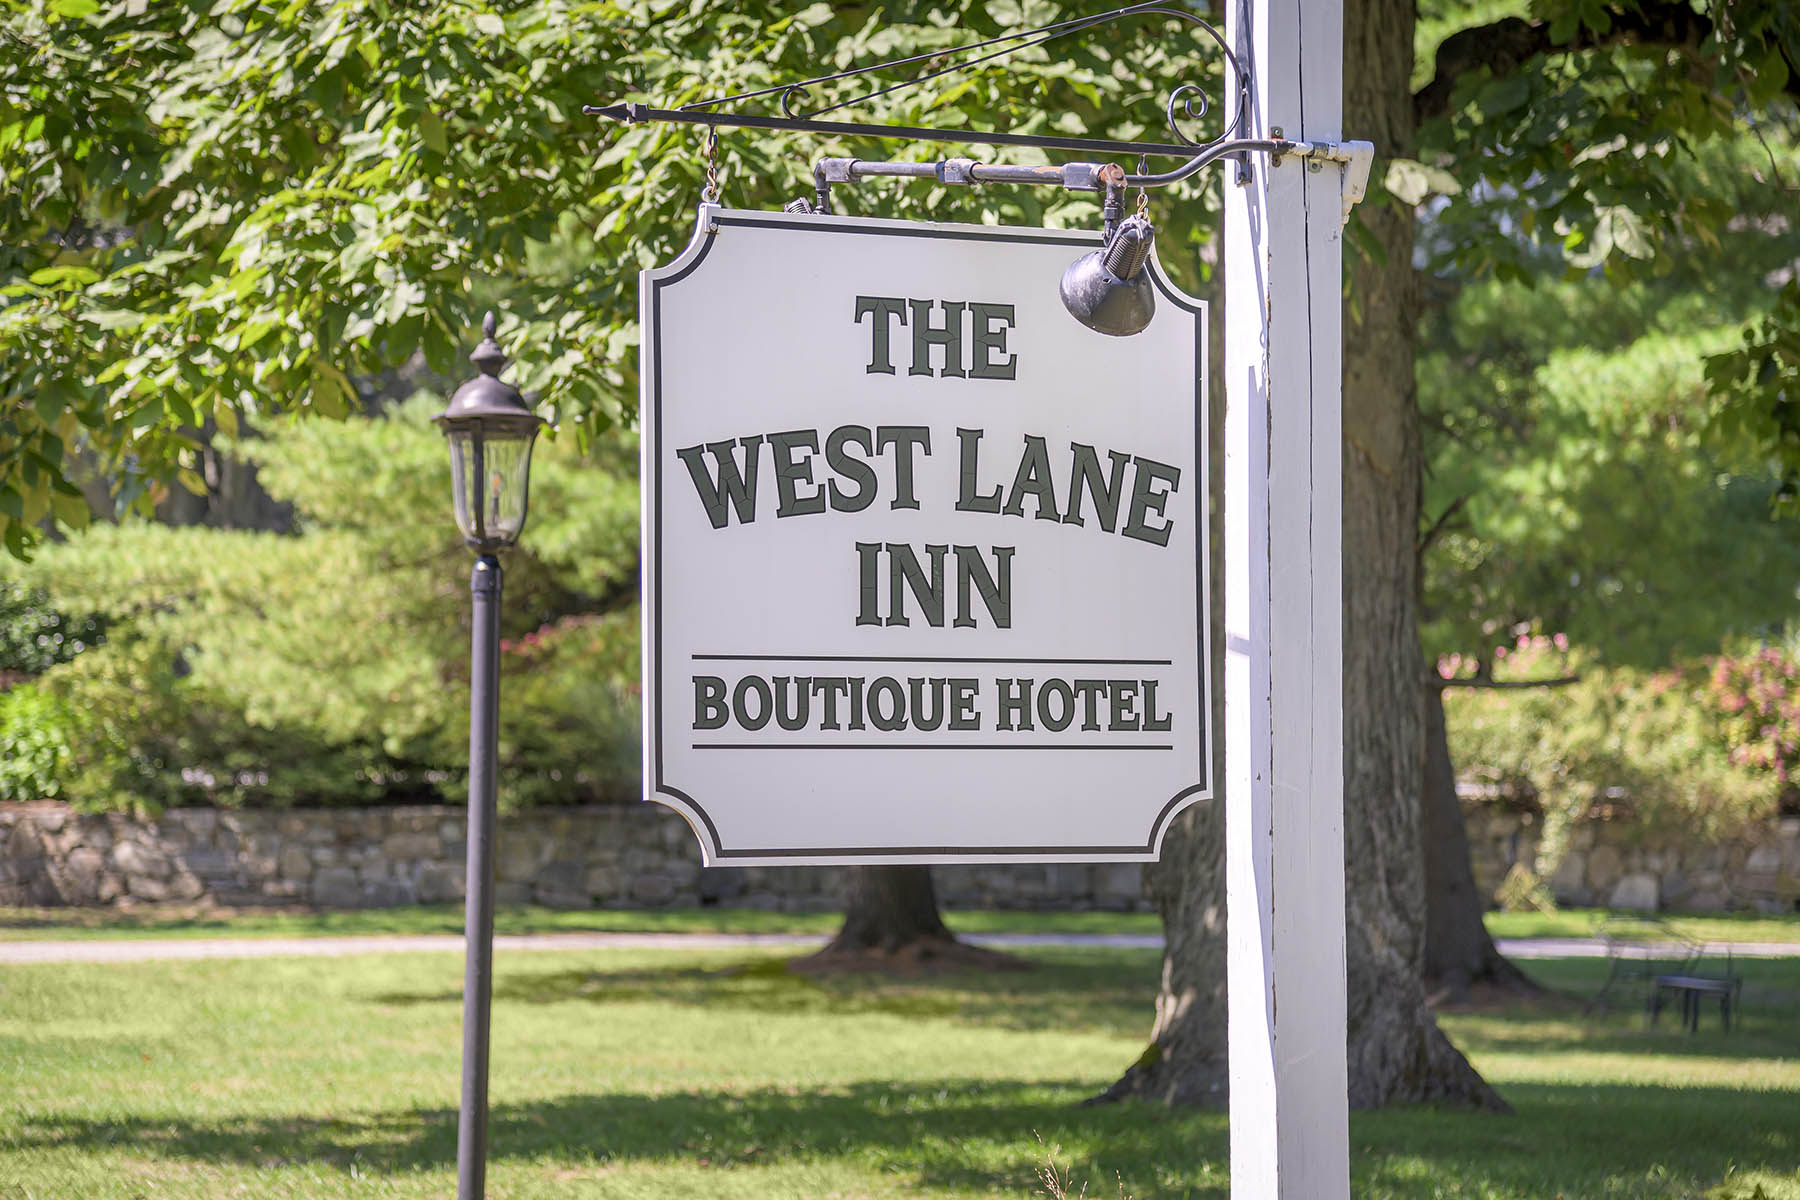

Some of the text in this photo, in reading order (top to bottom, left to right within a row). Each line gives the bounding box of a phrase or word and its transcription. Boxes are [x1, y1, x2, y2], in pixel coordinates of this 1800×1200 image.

[854, 296, 1017, 380] THE
[676, 425, 1181, 547] WEST LANE
[856, 542, 1015, 629] INN
[692, 675, 1172, 732] BOUTIQUE HOTEL
